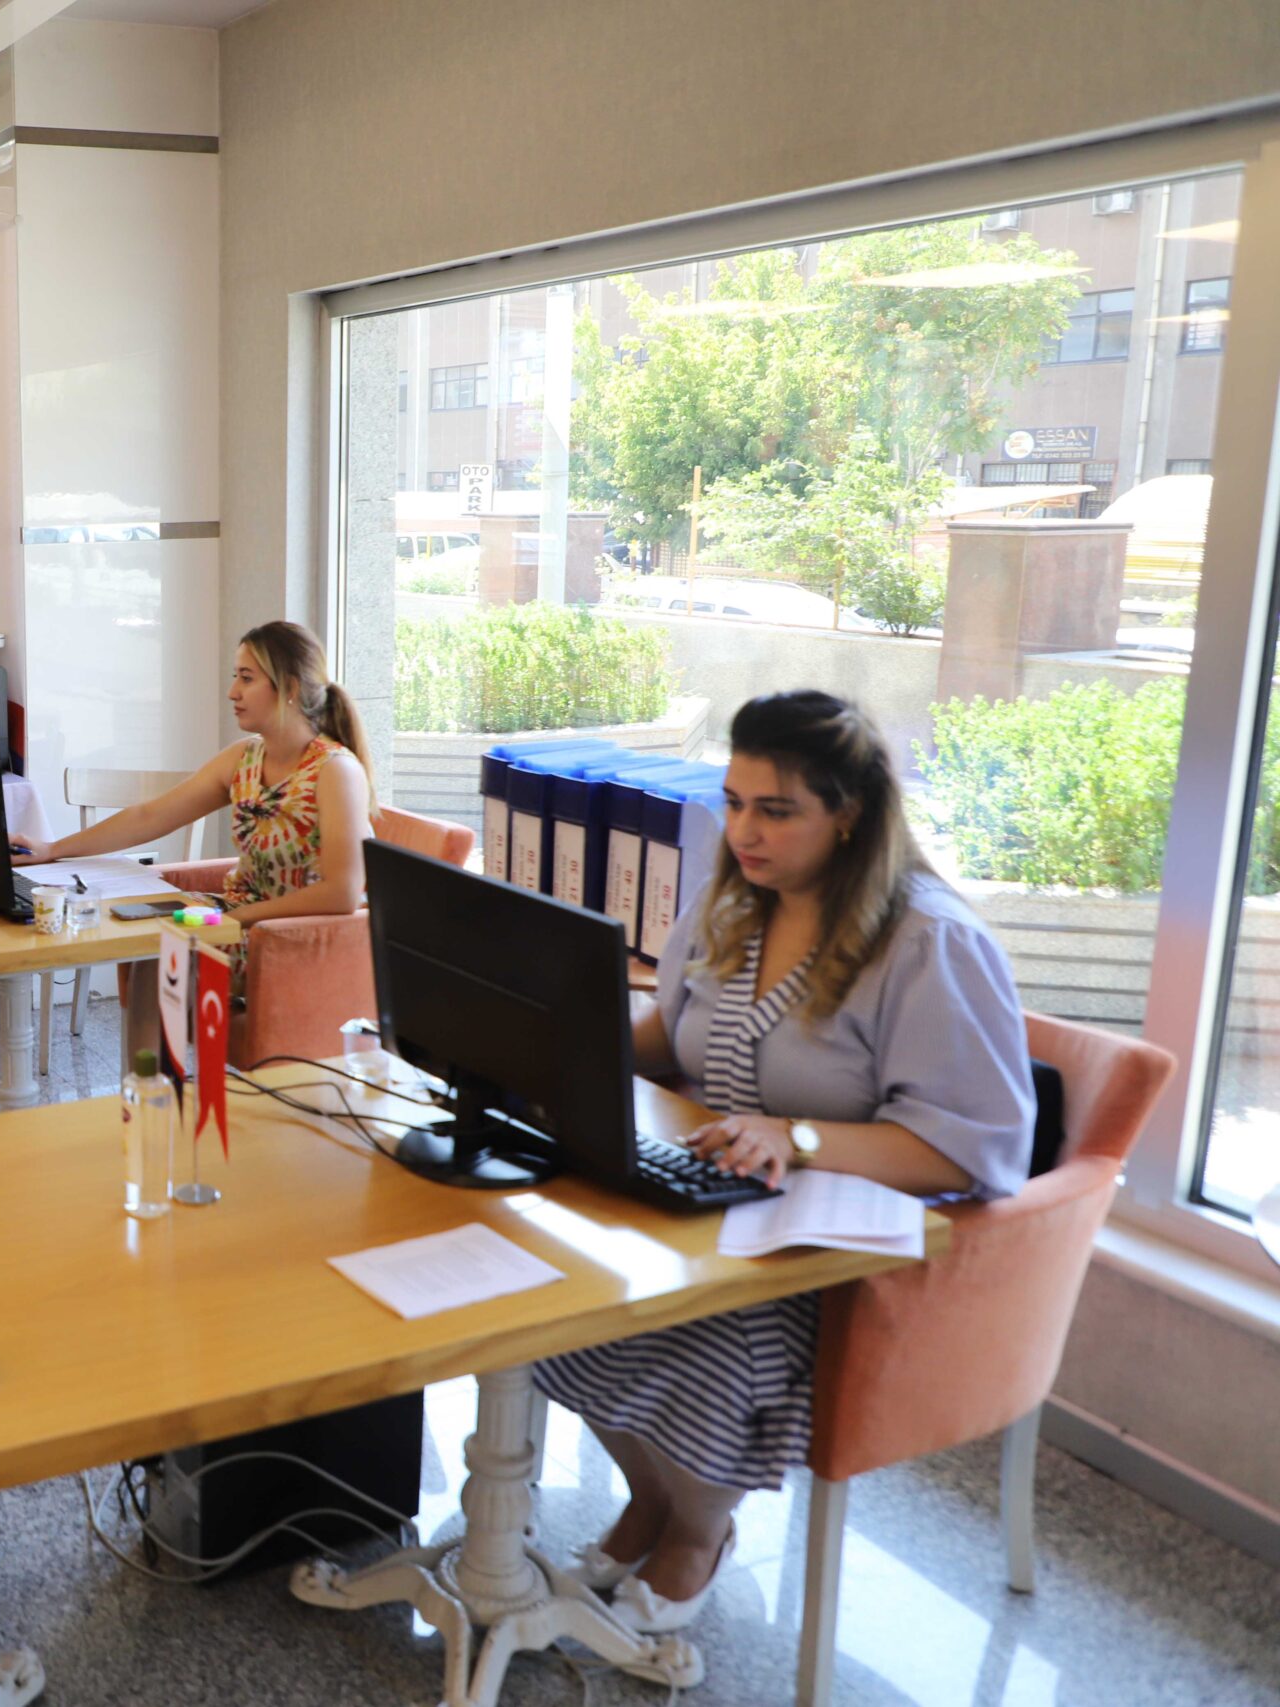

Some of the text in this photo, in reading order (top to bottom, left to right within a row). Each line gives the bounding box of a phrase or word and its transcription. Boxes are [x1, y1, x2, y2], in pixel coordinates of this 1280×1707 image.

[1036, 429, 1089, 443] ESSAN
[462, 466, 489, 476] OTO
[467, 477, 484, 512] PARK
